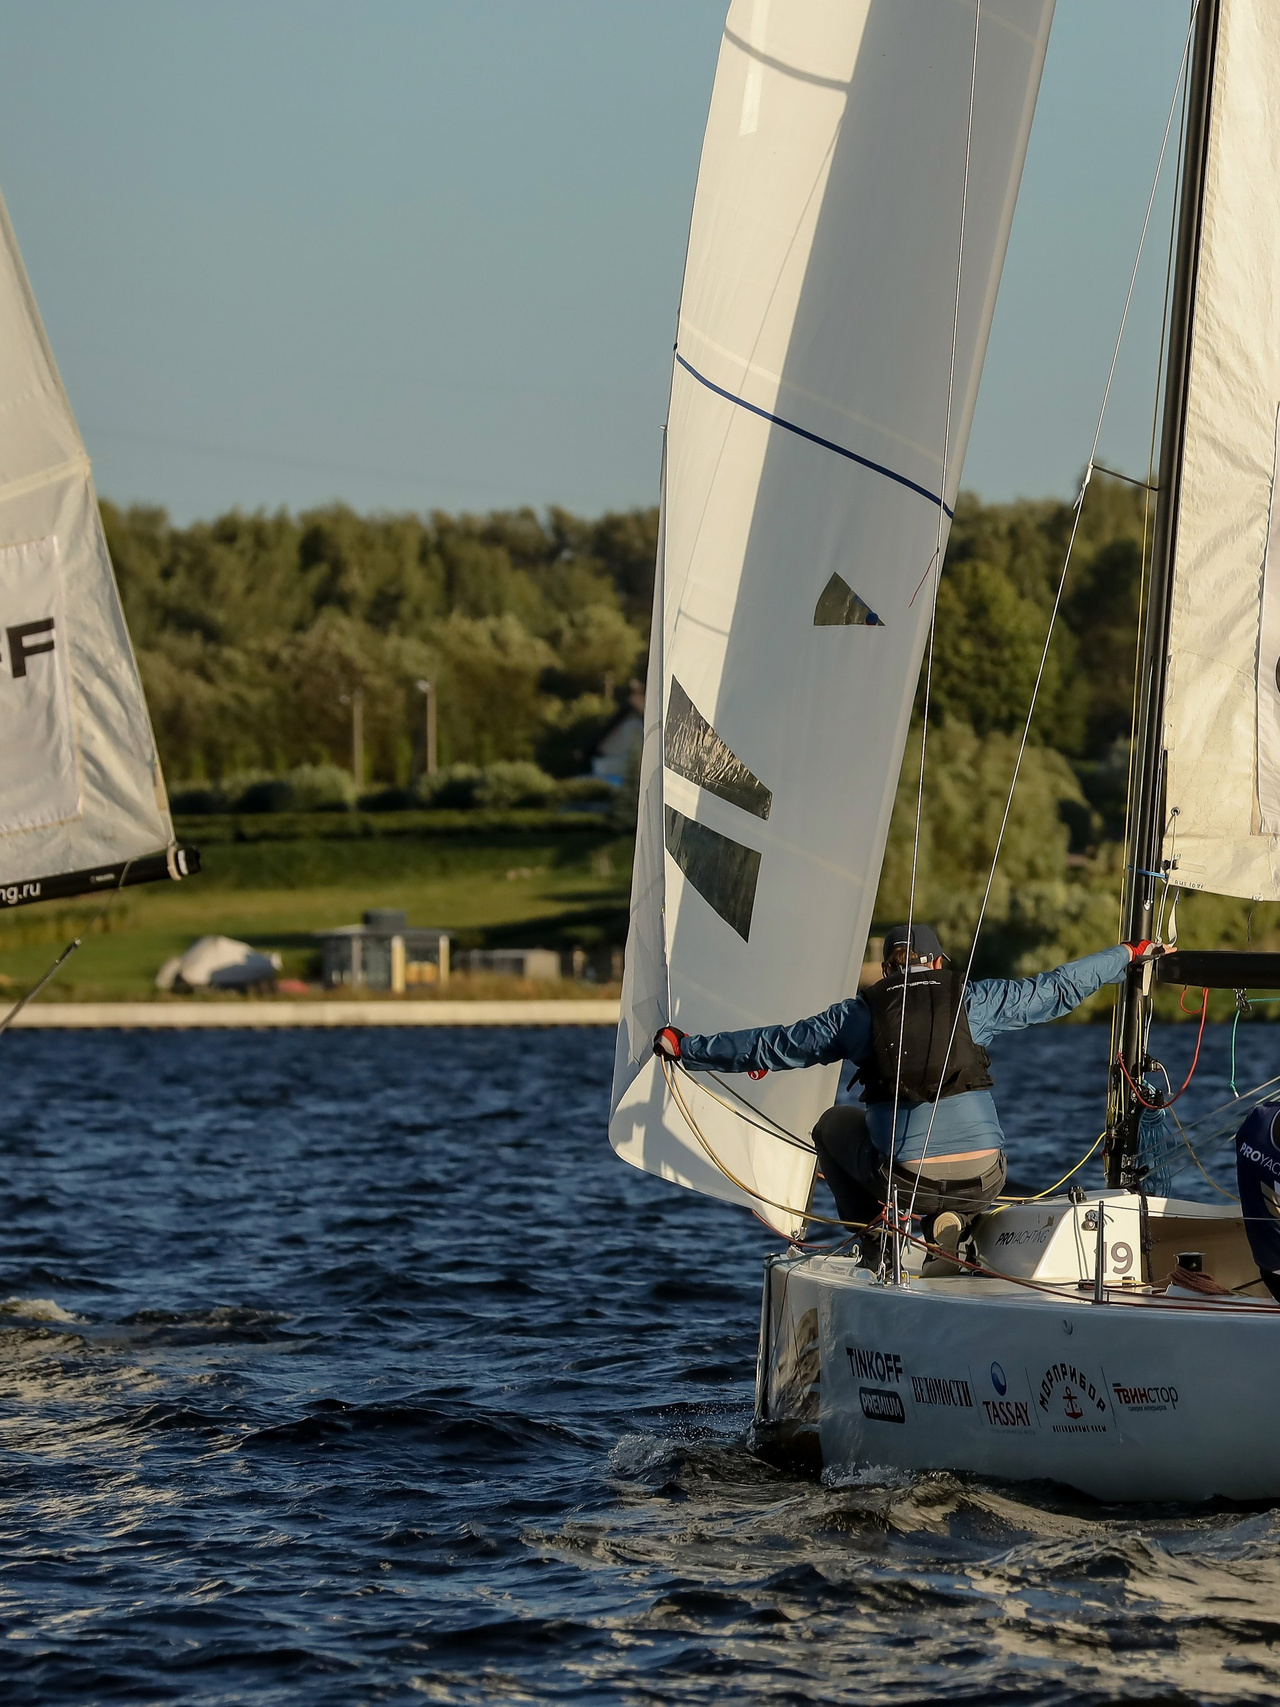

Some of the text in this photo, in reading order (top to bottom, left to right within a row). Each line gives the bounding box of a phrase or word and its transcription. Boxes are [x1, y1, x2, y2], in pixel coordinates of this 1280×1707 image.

[846, 1347, 903, 1383] TINKOFF
[1039, 1363, 1106, 1412] МОРПРИБОР
[860, 1392, 903, 1418] PREMIUM
[982, 1400, 1031, 1426] TASSAY
